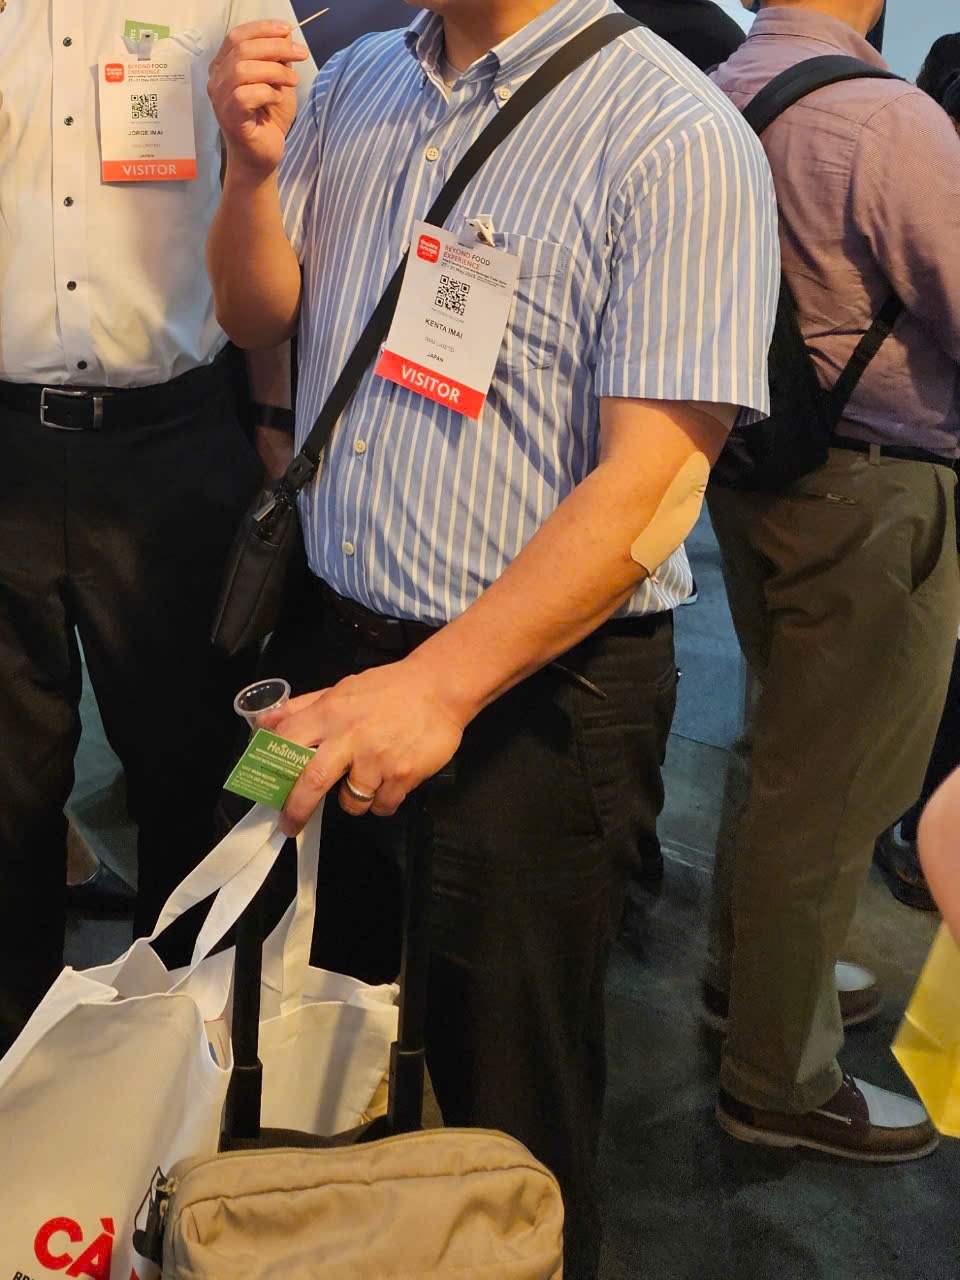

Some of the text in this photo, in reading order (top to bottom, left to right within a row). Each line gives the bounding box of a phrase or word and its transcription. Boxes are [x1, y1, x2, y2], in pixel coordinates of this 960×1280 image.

[121, 163, 177, 177] VISITOR
[443, 251, 481, 271] EXPERIENCE
[444, 244, 471, 259] BEYOND
[471, 254, 491, 266] FOOD
[425, 317, 463, 339] KENTA IMAI
[401, 364, 461, 404] VISITOR
[266, 740, 310, 766] HealthyN
[34, 1216, 115, 1280] CÀ
